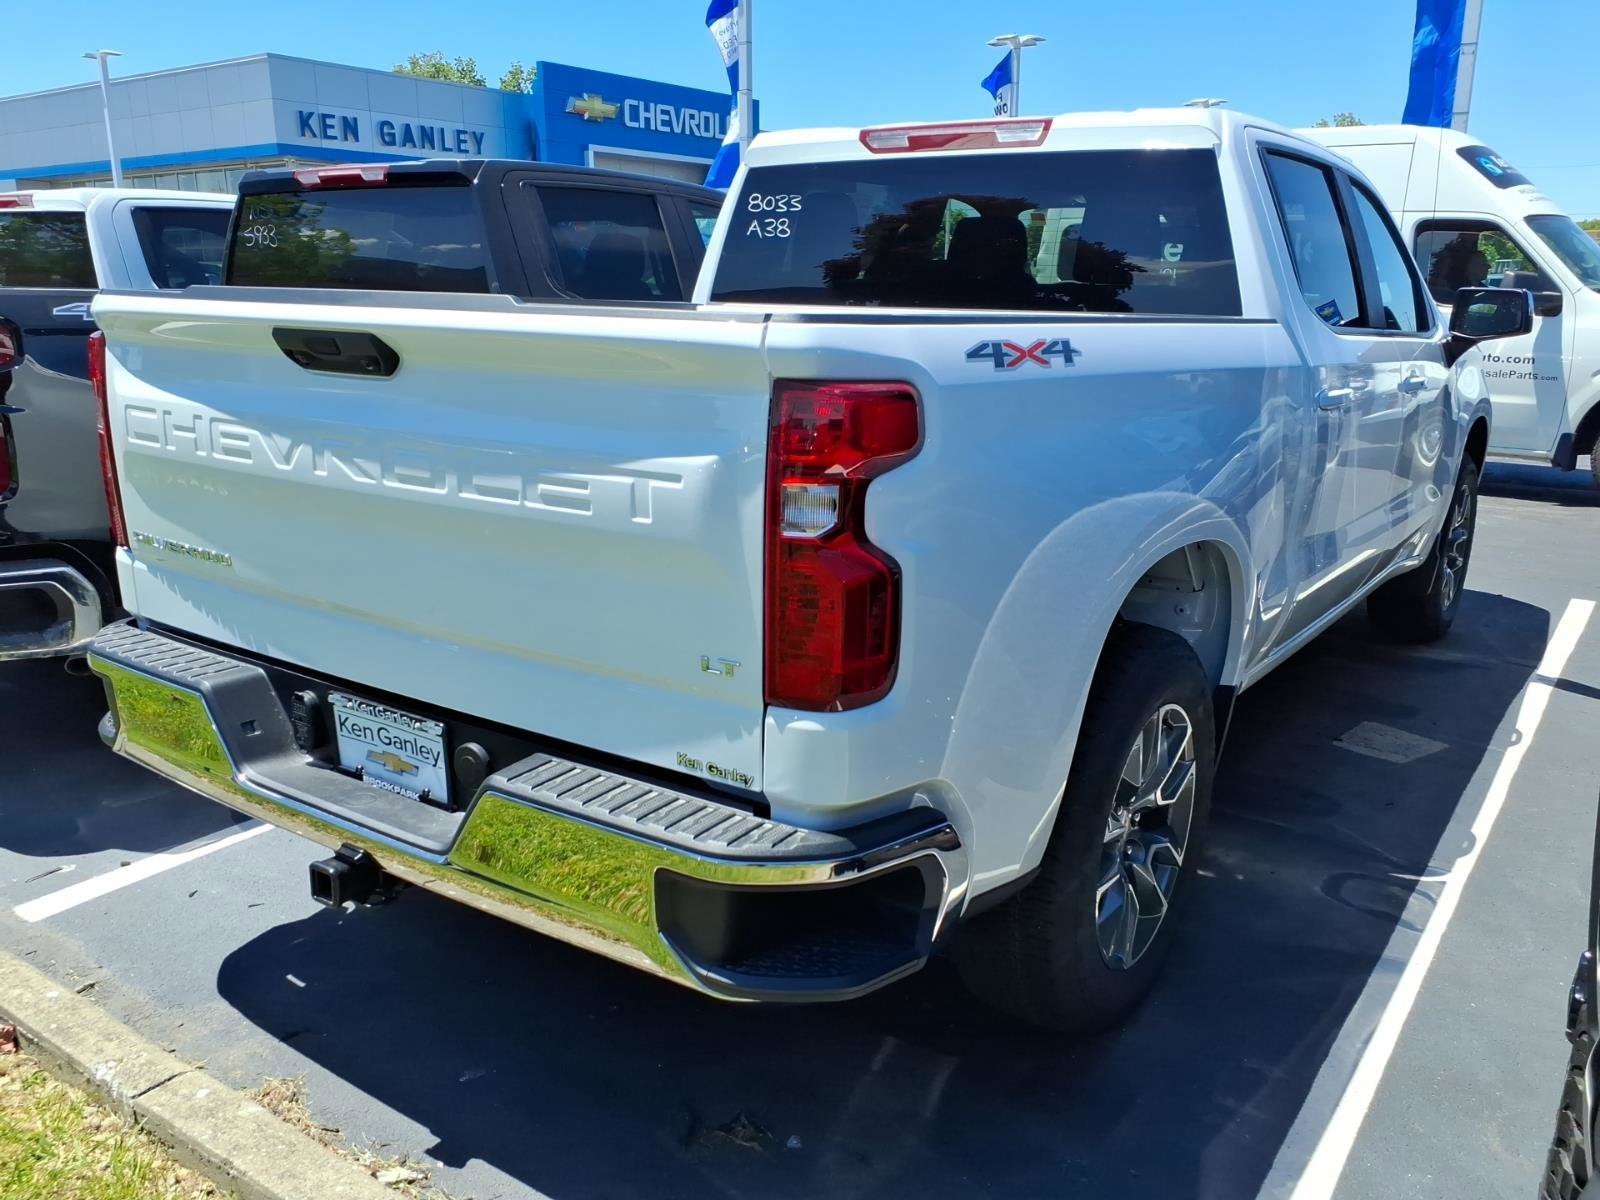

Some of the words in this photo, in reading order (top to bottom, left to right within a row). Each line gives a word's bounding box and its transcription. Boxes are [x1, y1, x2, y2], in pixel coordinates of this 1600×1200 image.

[297, 110, 359, 142] KEN
[377, 120, 485, 155] GANLEY
[624, 98, 730, 139] CHEVROL
[747, 193, 802, 212] 8033
[746, 218, 791, 239] A38
[125, 403, 684, 525] CHEVROLET
[700, 655, 741, 678] LT
[338, 714, 375, 742] Ken
[377, 726, 440, 768] Ganley
[676, 751, 704, 772] Ken
[706, 761, 755, 788] Ganley
